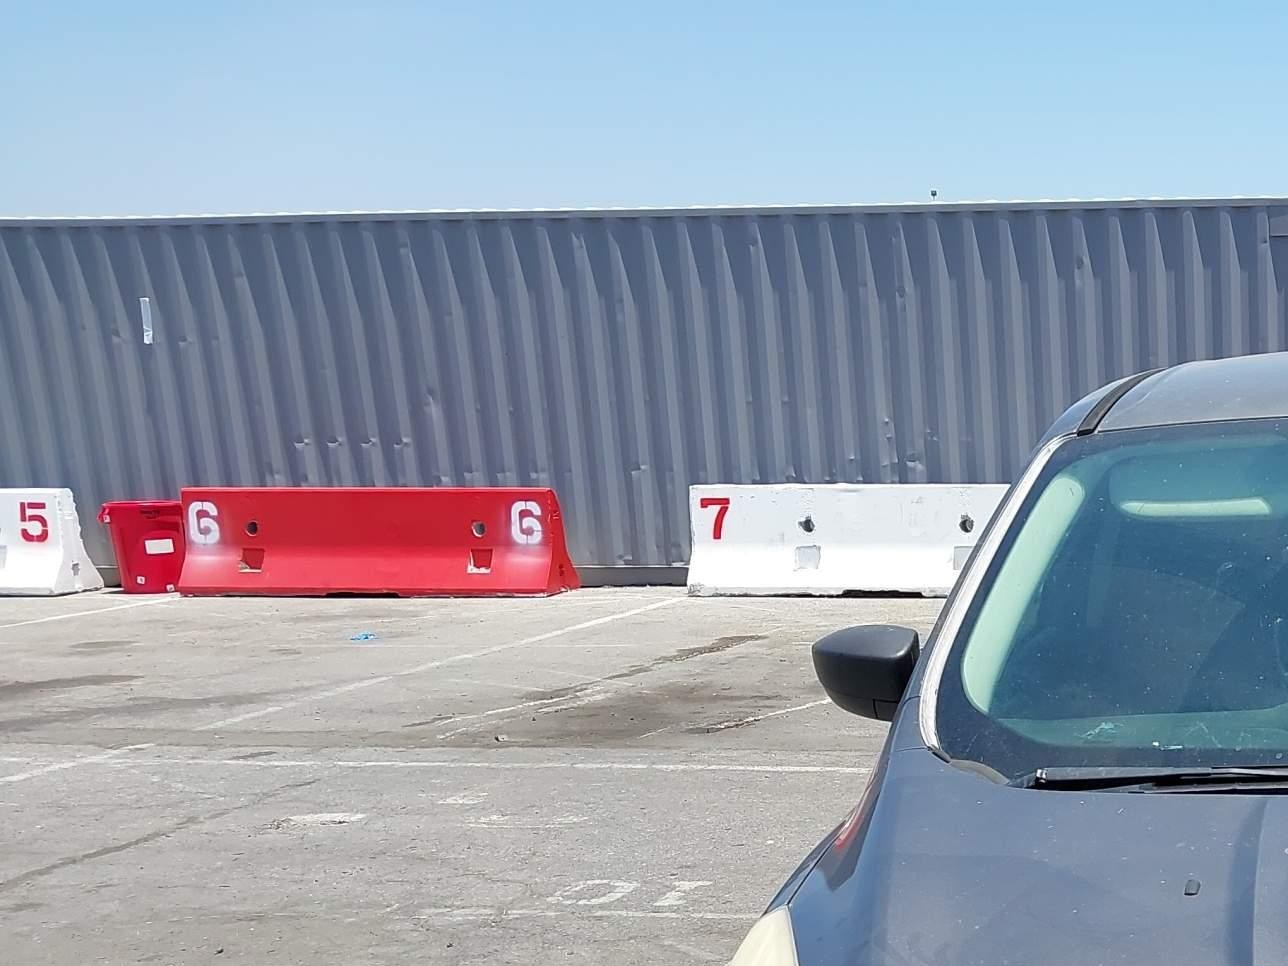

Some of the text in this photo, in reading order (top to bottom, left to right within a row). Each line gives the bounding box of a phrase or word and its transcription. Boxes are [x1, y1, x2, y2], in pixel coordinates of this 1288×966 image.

[19, 502, 49, 543] 5
[188, 501, 220, 544] 6
[510, 501, 542, 544] 6
[700, 497, 731, 540] 7
